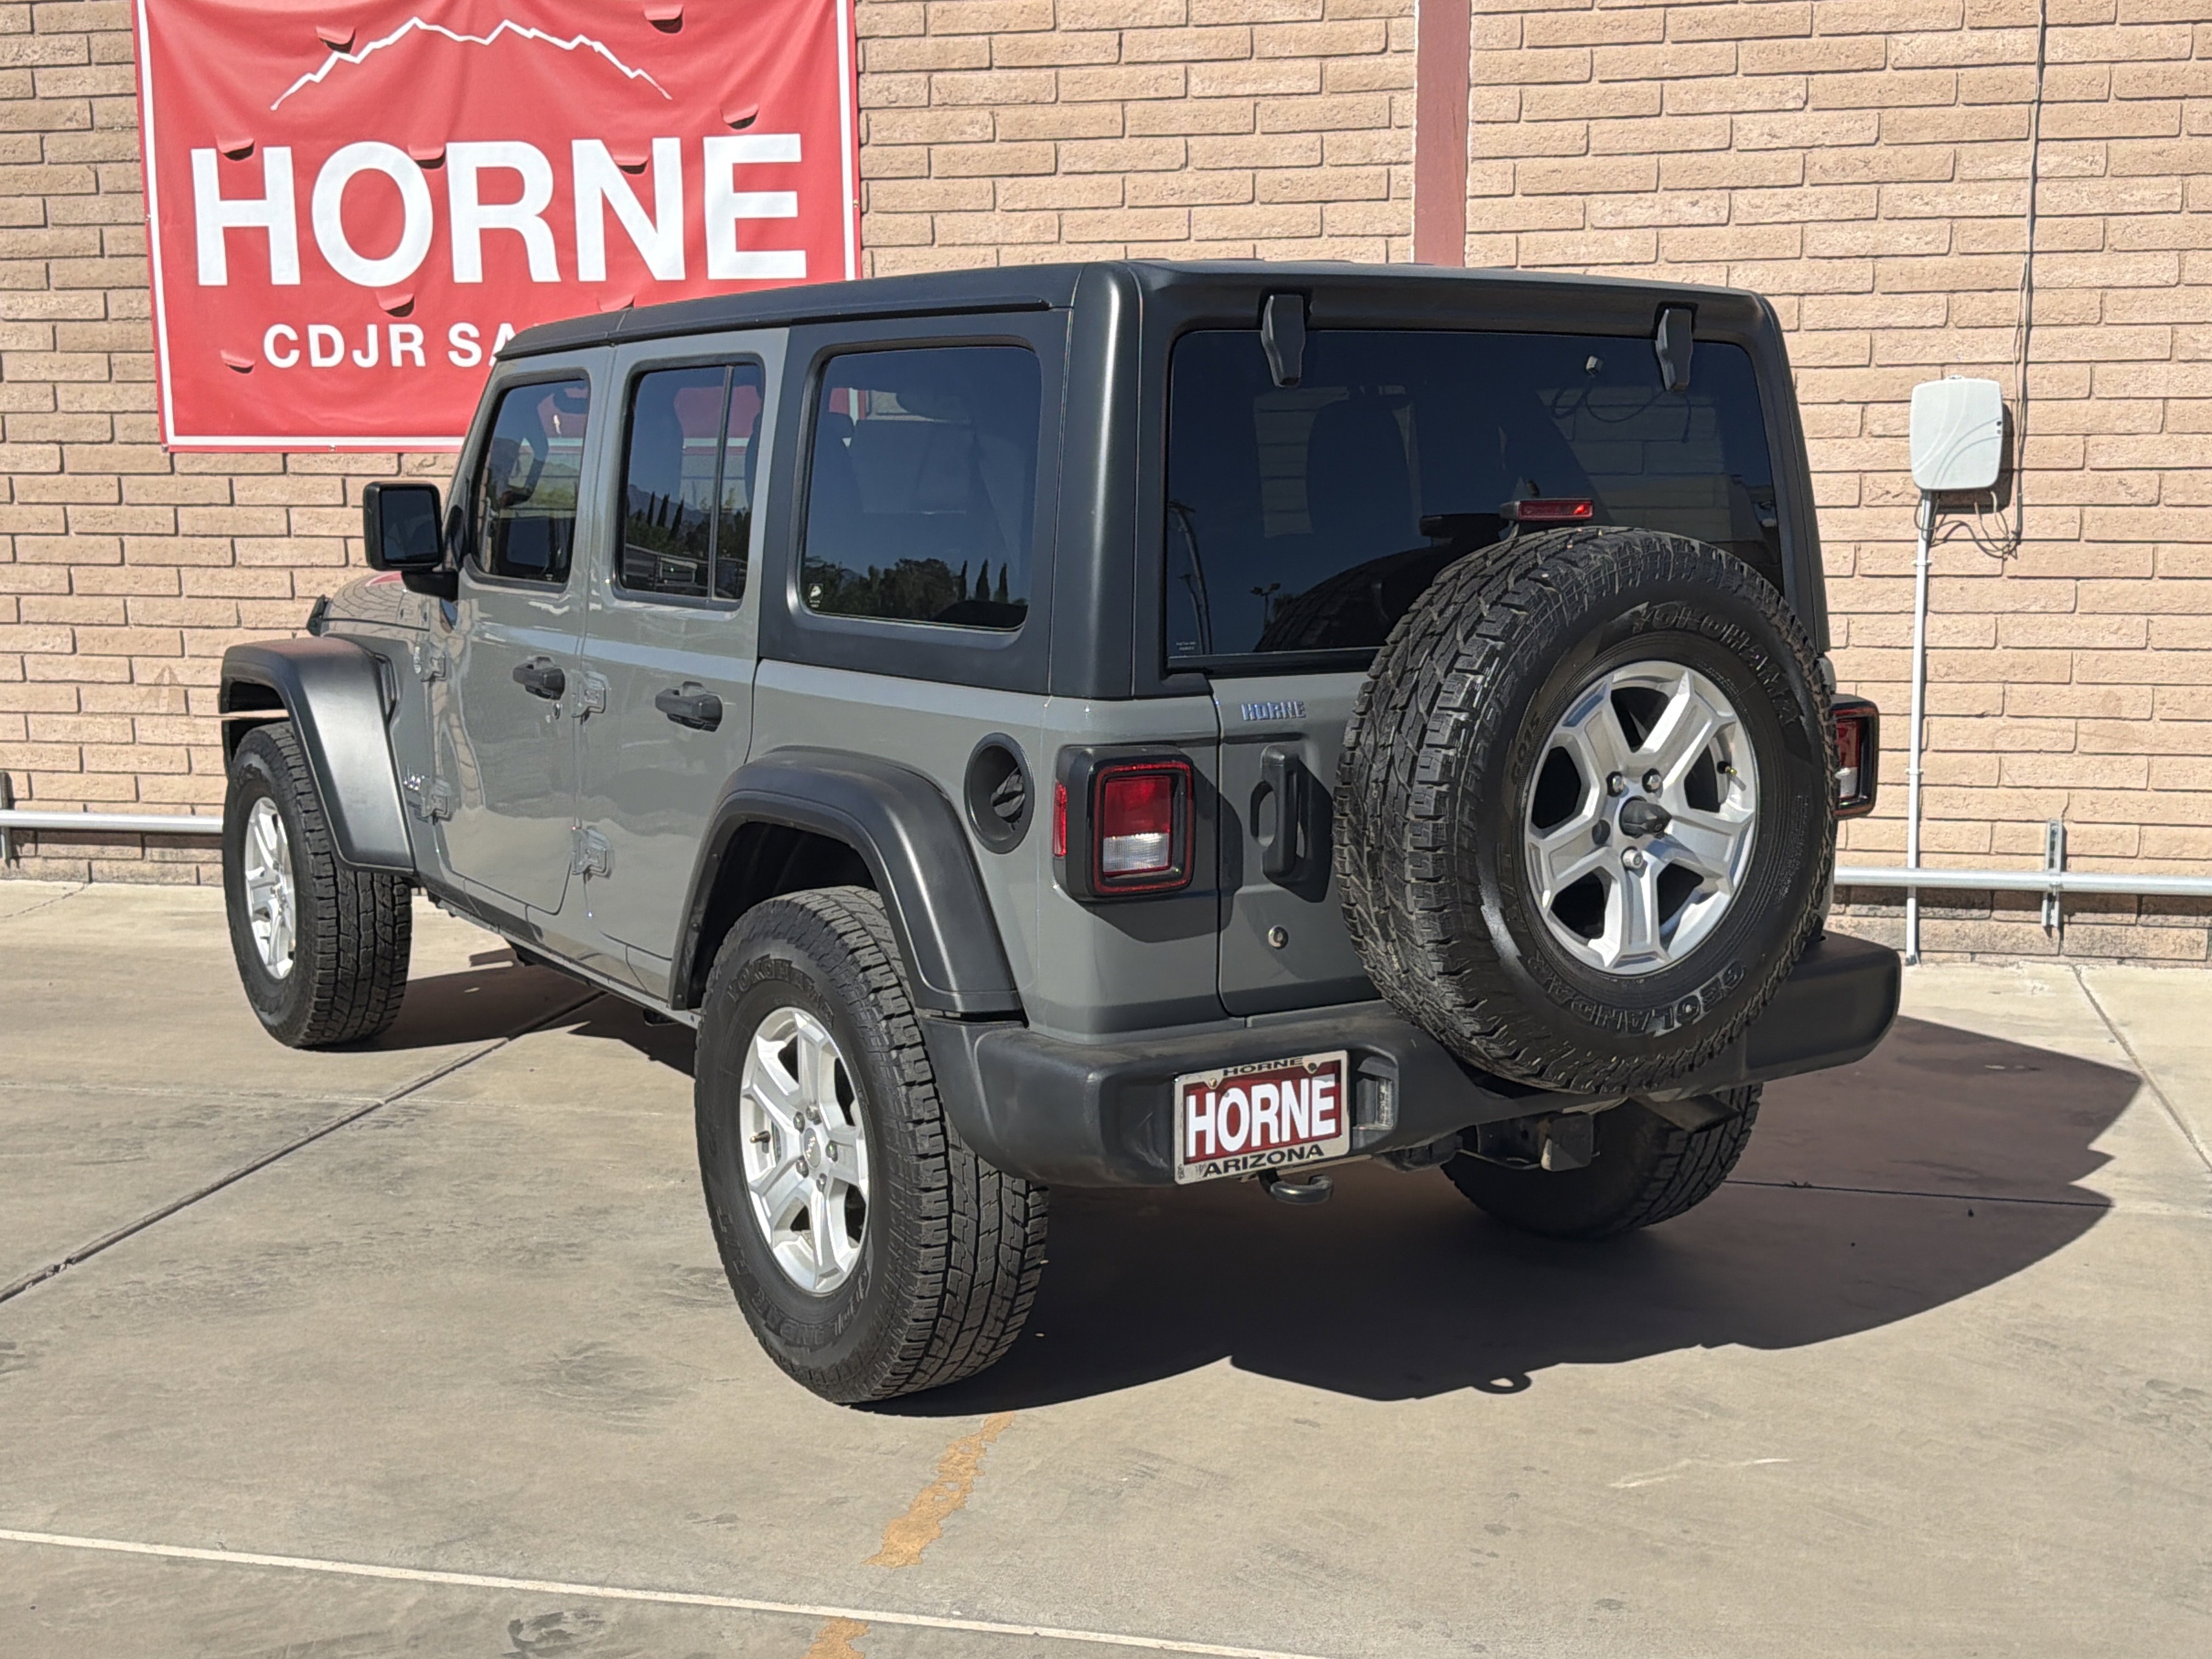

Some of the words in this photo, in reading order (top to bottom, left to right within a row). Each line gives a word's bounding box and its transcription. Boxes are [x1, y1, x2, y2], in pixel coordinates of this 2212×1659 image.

[189, 133, 808, 287] HORNE
[263, 323, 426, 368] CDJR
[1241, 701, 1306, 721] HORNE
[1223, 1057, 1304, 1076] HORNE
[1186, 1073, 1336, 1158] HORNE
[1203, 1144, 1324, 1178] ARIZONA
